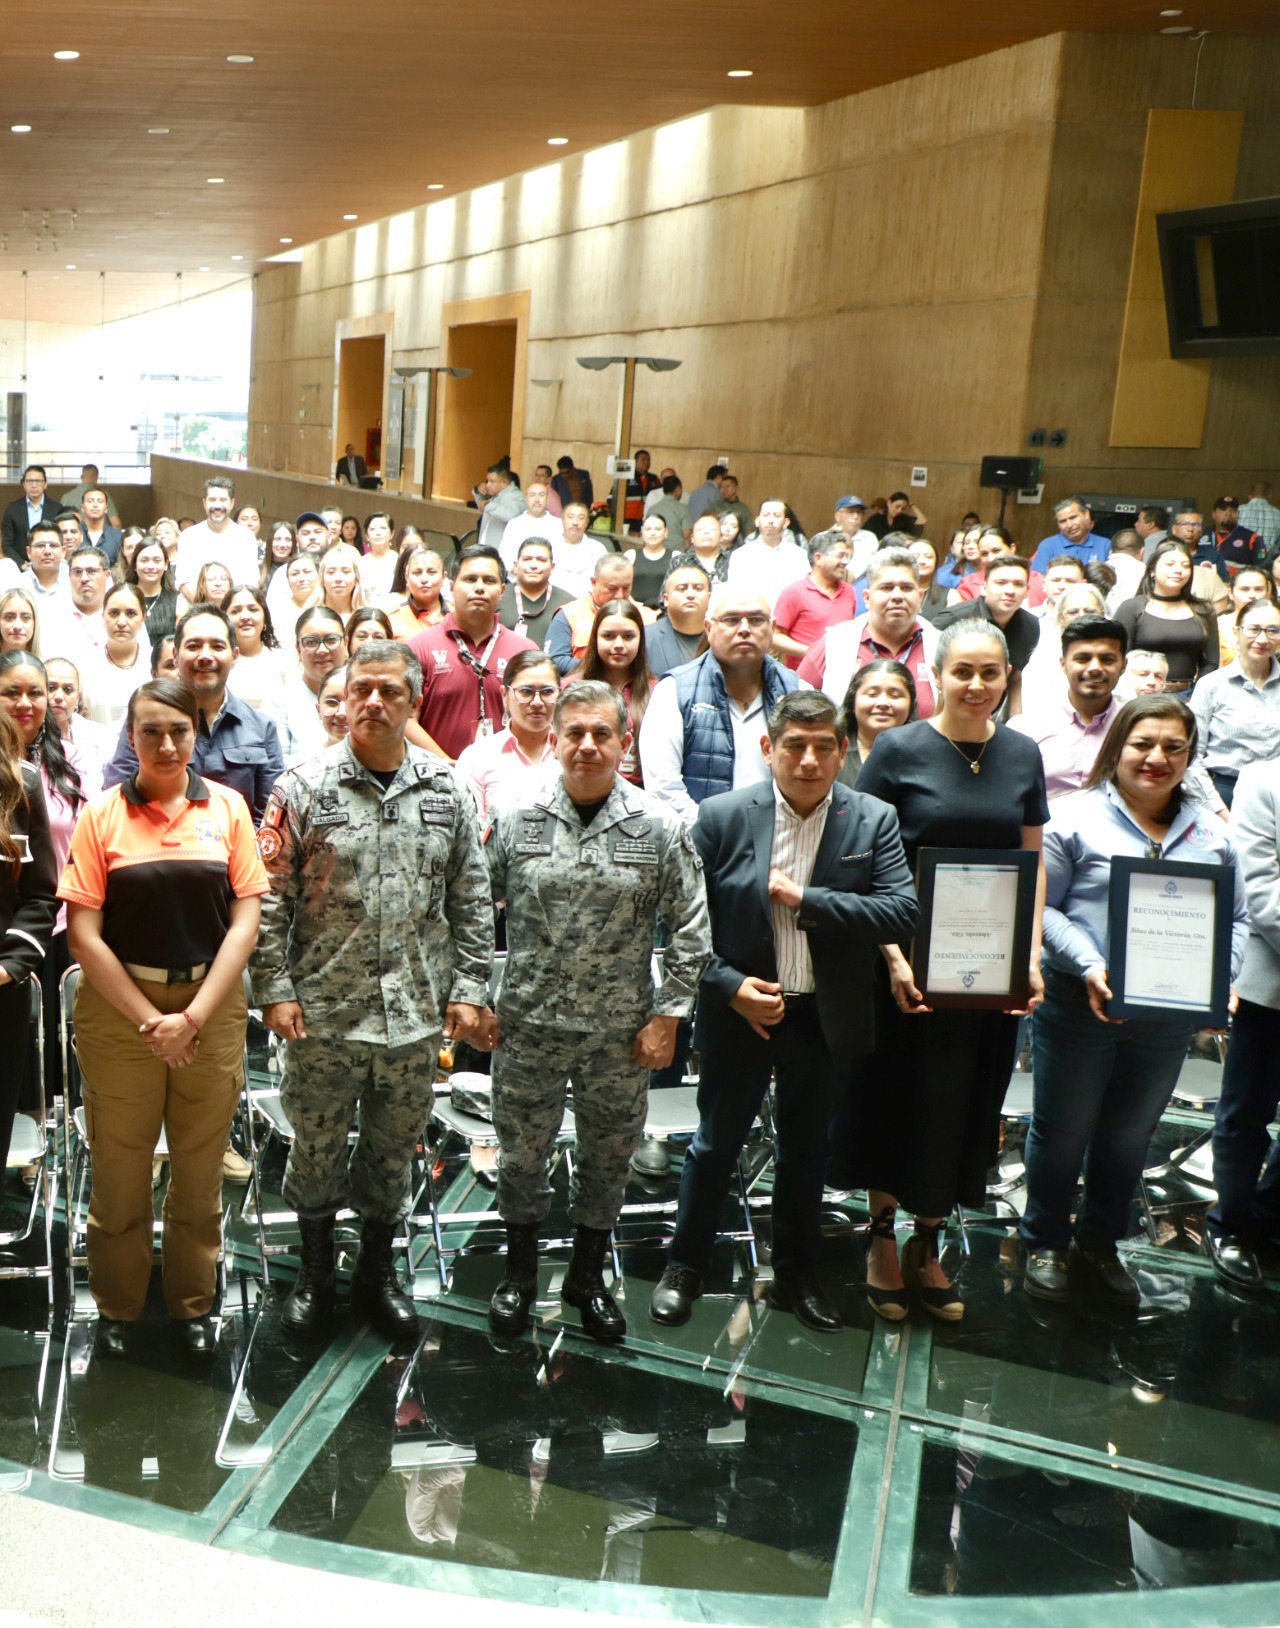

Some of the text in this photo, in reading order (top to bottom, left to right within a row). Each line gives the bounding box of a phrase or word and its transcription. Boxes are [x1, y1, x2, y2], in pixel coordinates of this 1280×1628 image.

[314, 815, 345, 823] SALGADO
[1133, 907, 1206, 919] RECONOCIMIENTO
[934, 952, 1006, 960] RECONOCIMIENTO
